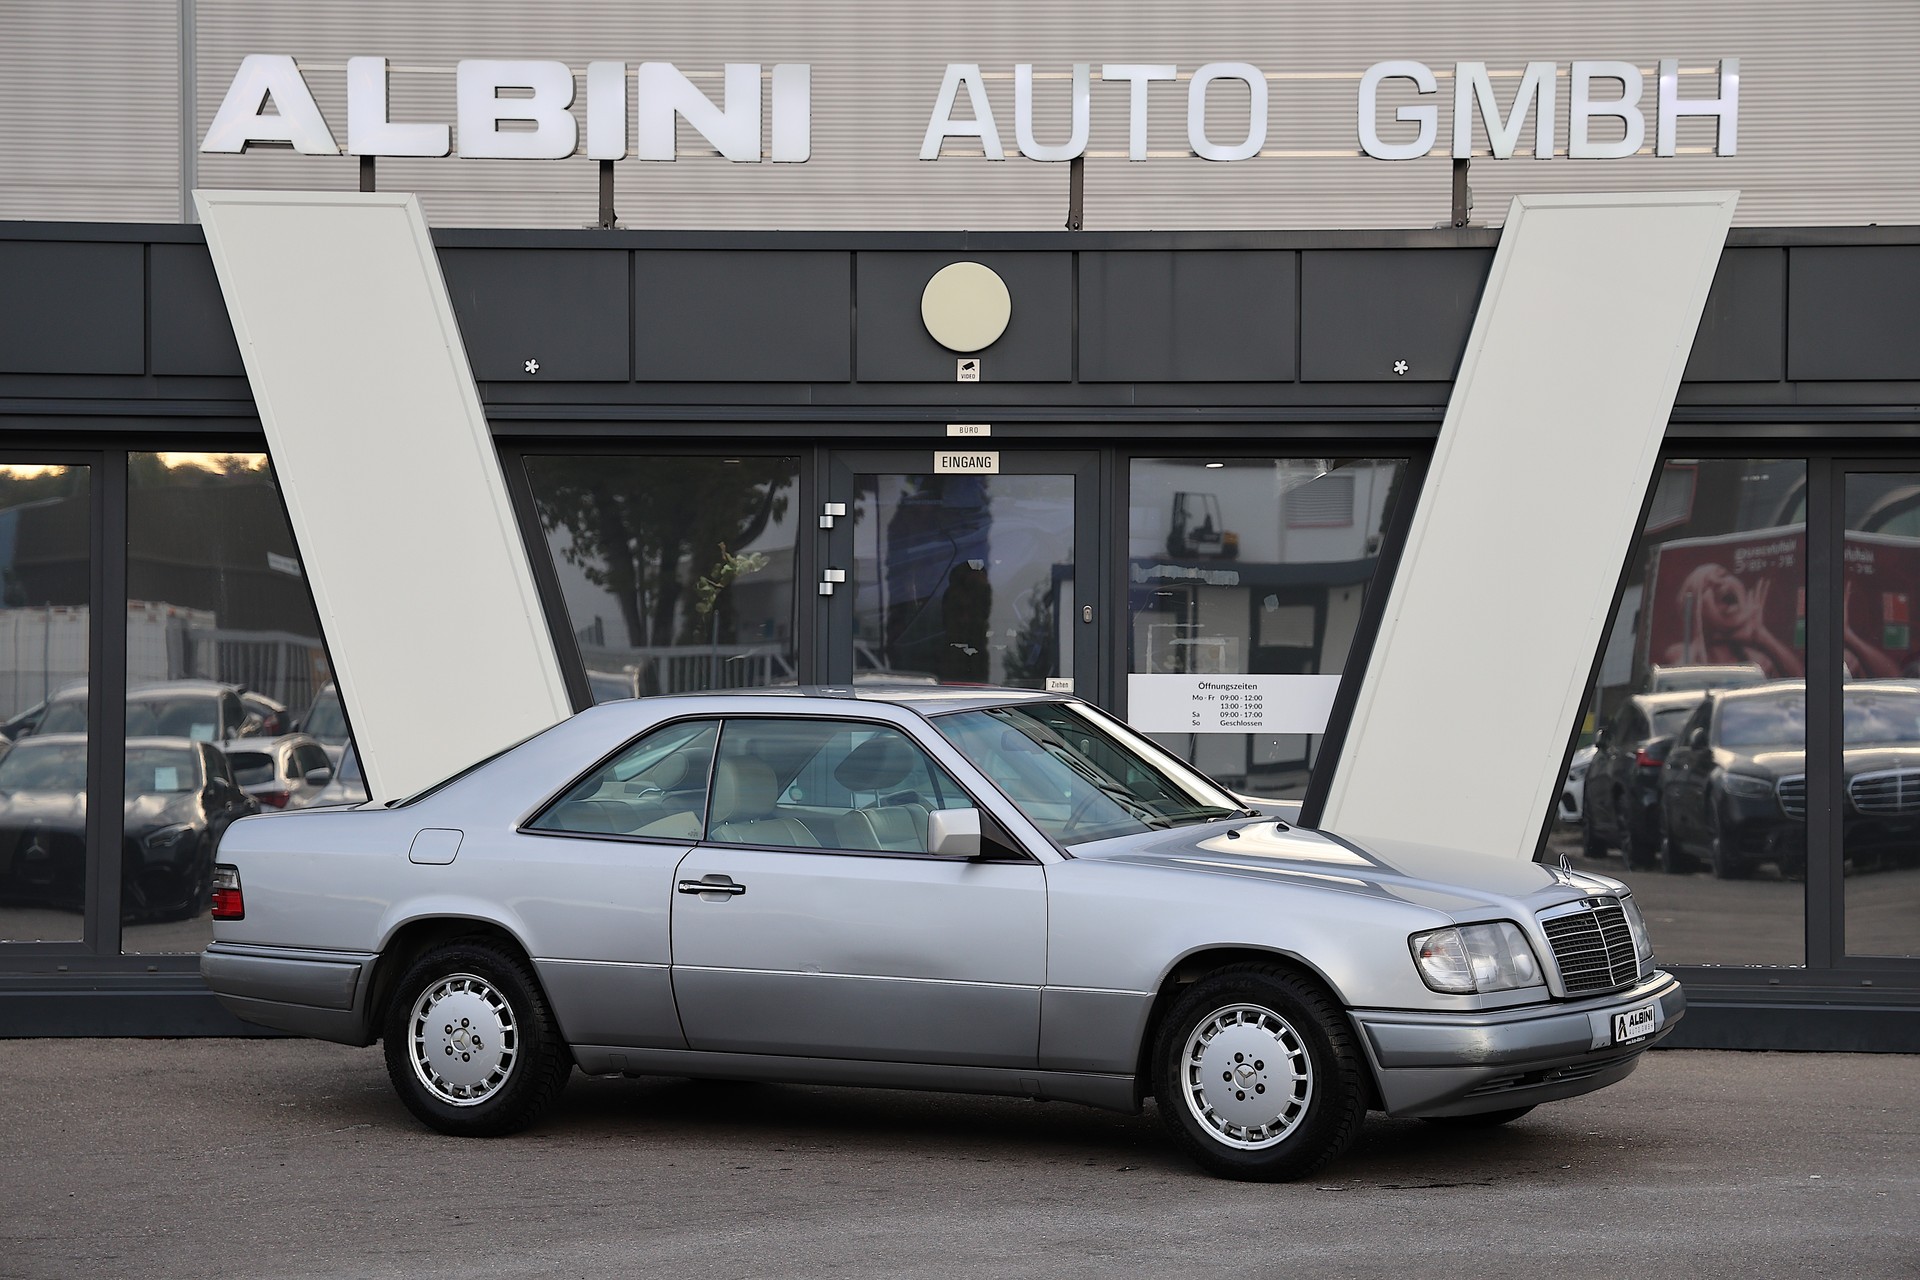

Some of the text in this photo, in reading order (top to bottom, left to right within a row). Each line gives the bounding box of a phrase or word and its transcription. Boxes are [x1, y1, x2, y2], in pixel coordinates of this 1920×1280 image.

[200, 54, 1741, 163] ALBINI AUTO GMBH
[959, 426, 979, 434] BÜRO
[942, 456, 992, 468] EINGANG
[1051, 680, 1069, 688] Ziehen
[1198, 681, 1258, 691] Öffnungszeiten
[1629, 1009, 1653, 1027] ALBINI
